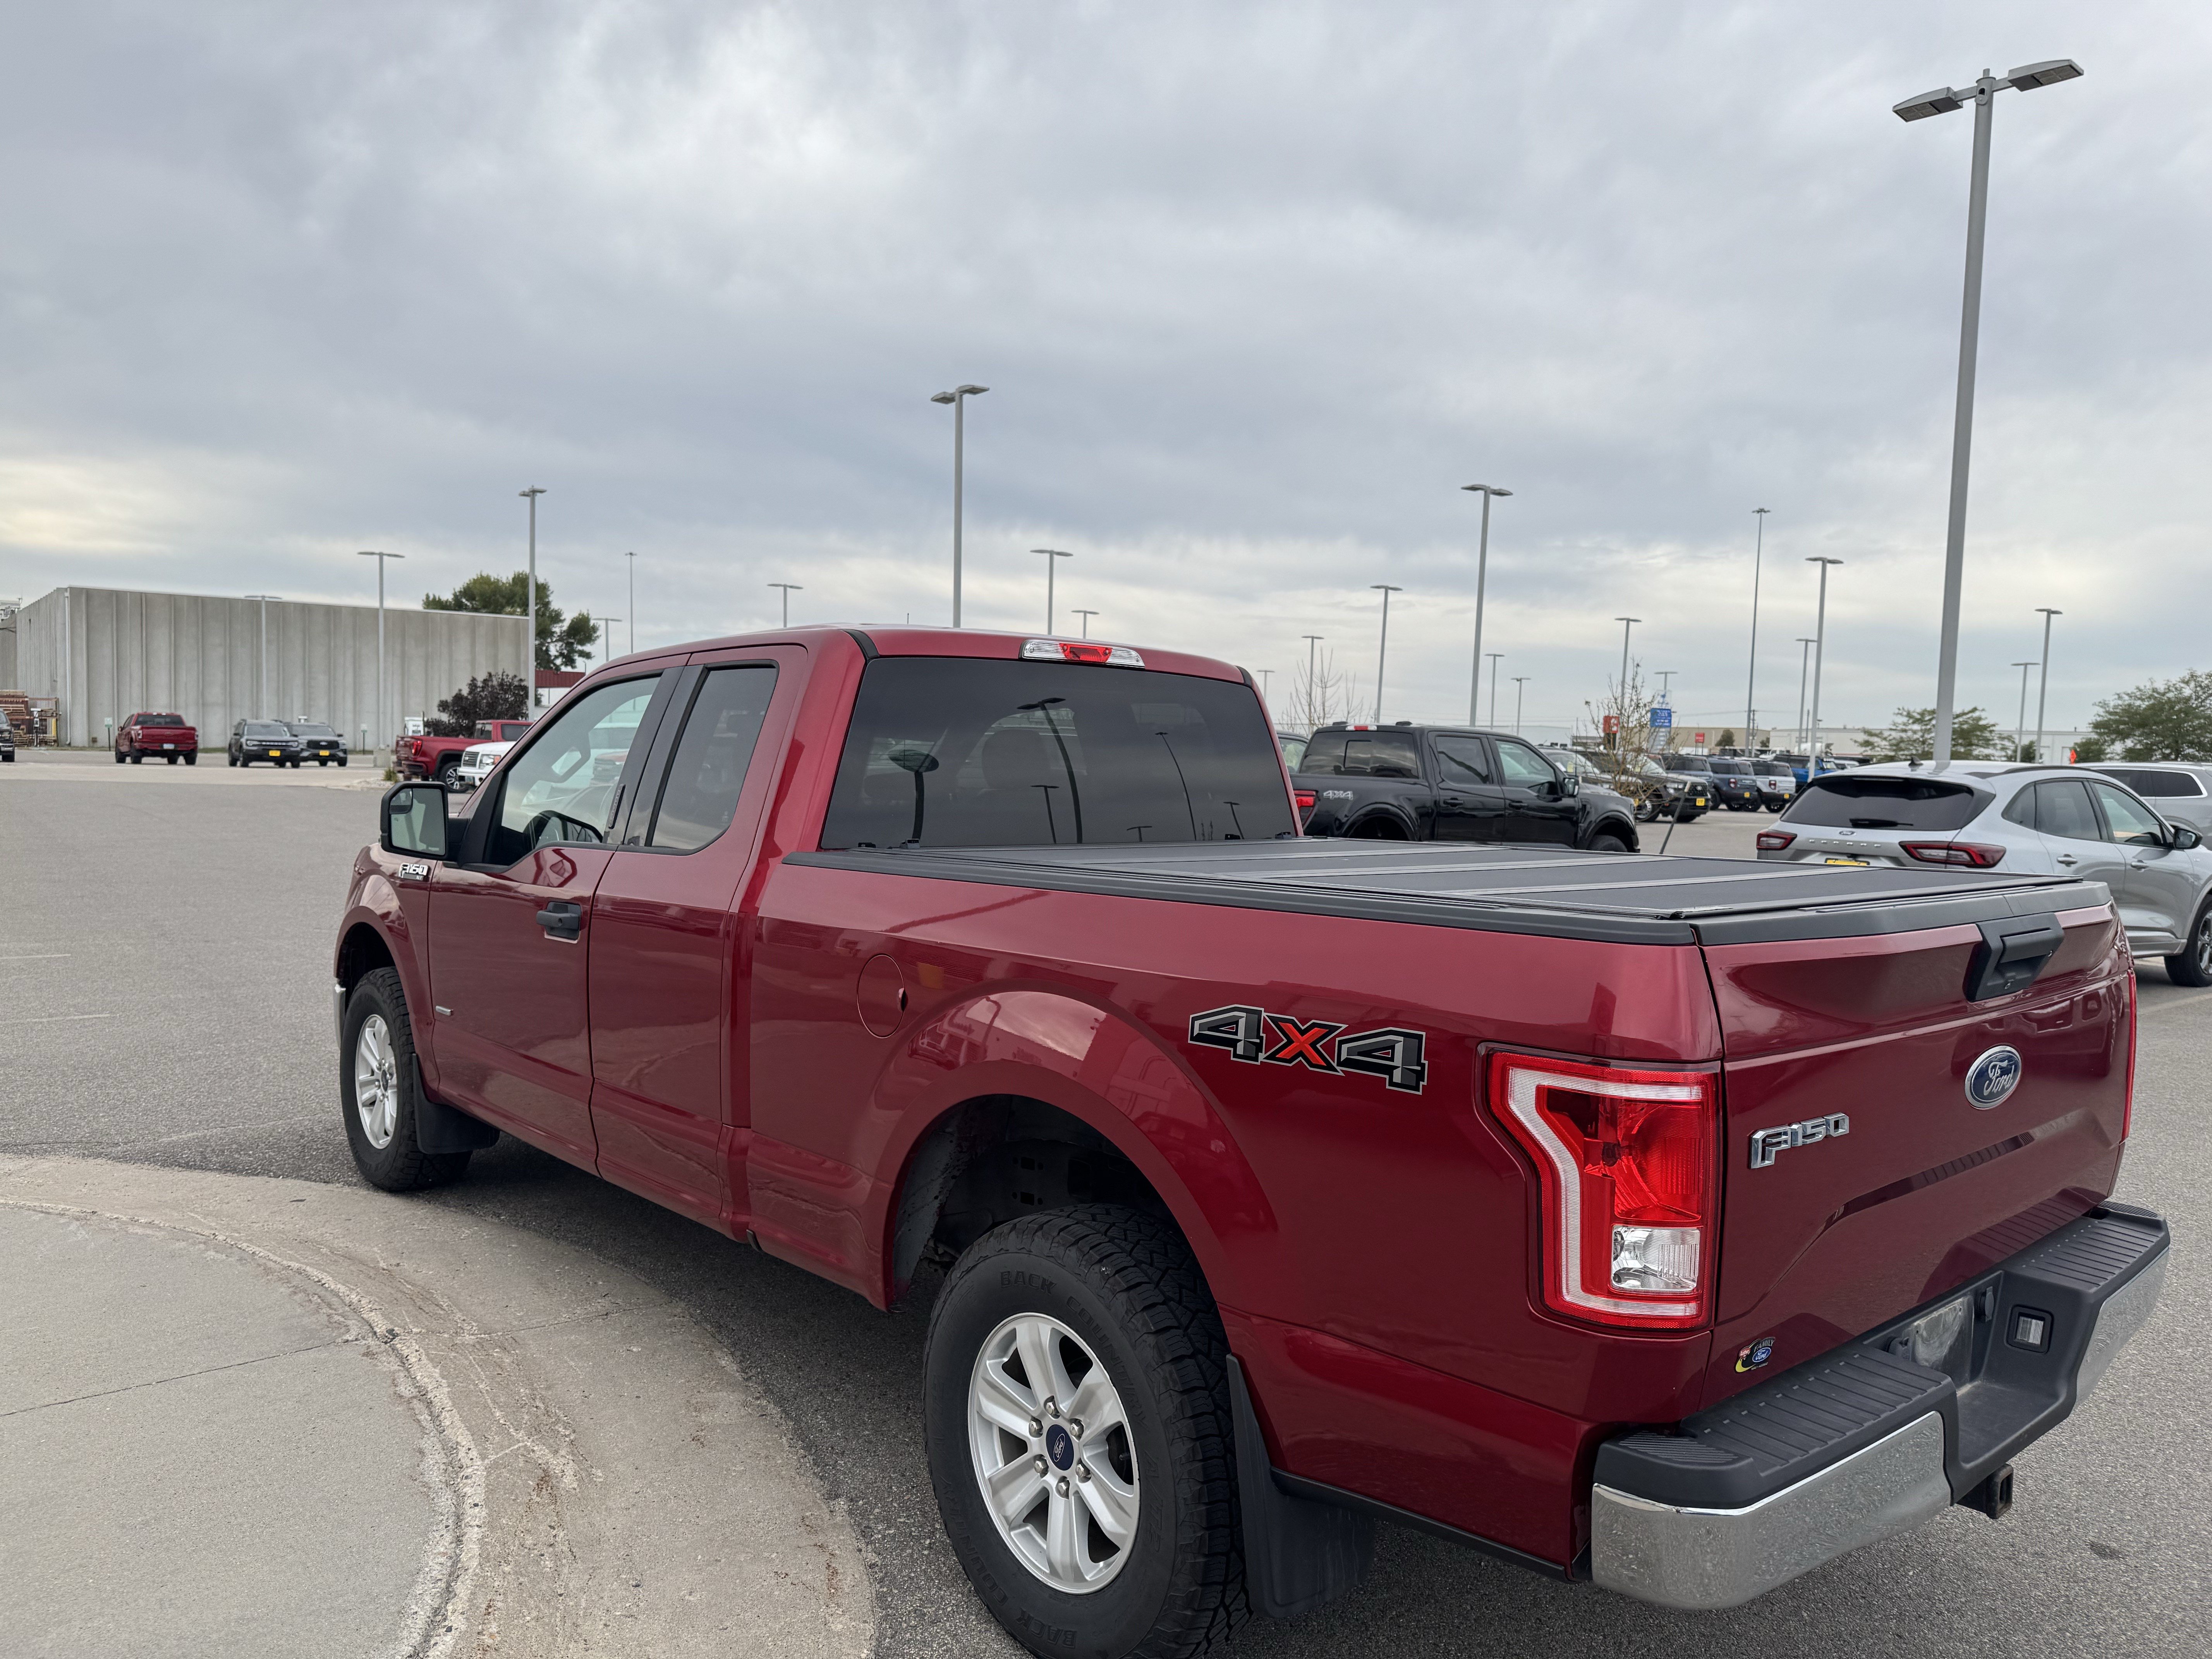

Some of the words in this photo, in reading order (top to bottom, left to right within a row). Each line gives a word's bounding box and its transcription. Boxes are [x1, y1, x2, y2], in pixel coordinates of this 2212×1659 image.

[1984, 1060, 2014, 1096] Ford
[1750, 1112, 1849, 1169] F150
[1000, 1270, 1058, 1295] BACK
[1065, 1295, 1149, 1429] COUNTRY
[1755, 1349, 1768, 1360] Ford
[1055, 1438, 1063, 1458] Ford
[1015, 1606, 1078, 1650] BACK
